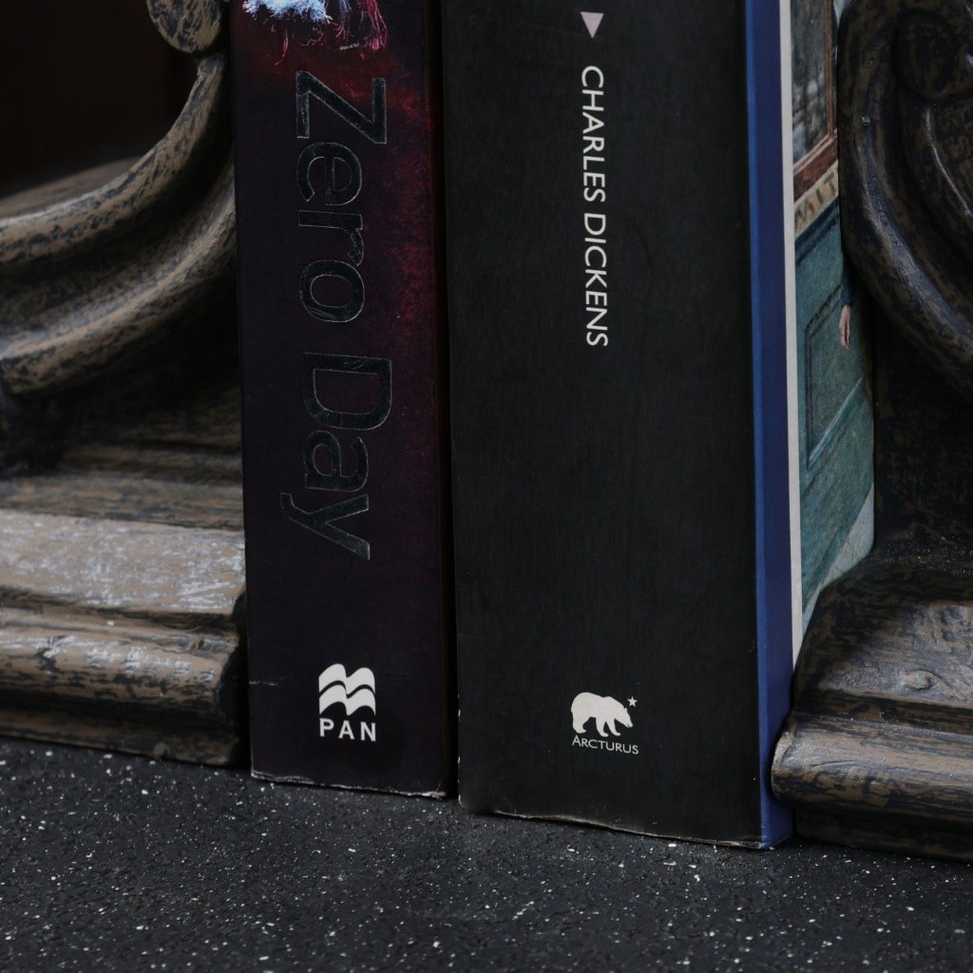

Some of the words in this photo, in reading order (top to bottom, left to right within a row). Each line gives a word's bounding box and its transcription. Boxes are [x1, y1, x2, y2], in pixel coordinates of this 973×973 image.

[296, 70, 388, 324] Zero
[581, 65, 607, 203] CHARLES
[583, 212, 609, 347] DICKENS
[280, 351, 393, 561] Day
[319, 718, 377, 743] PAN
